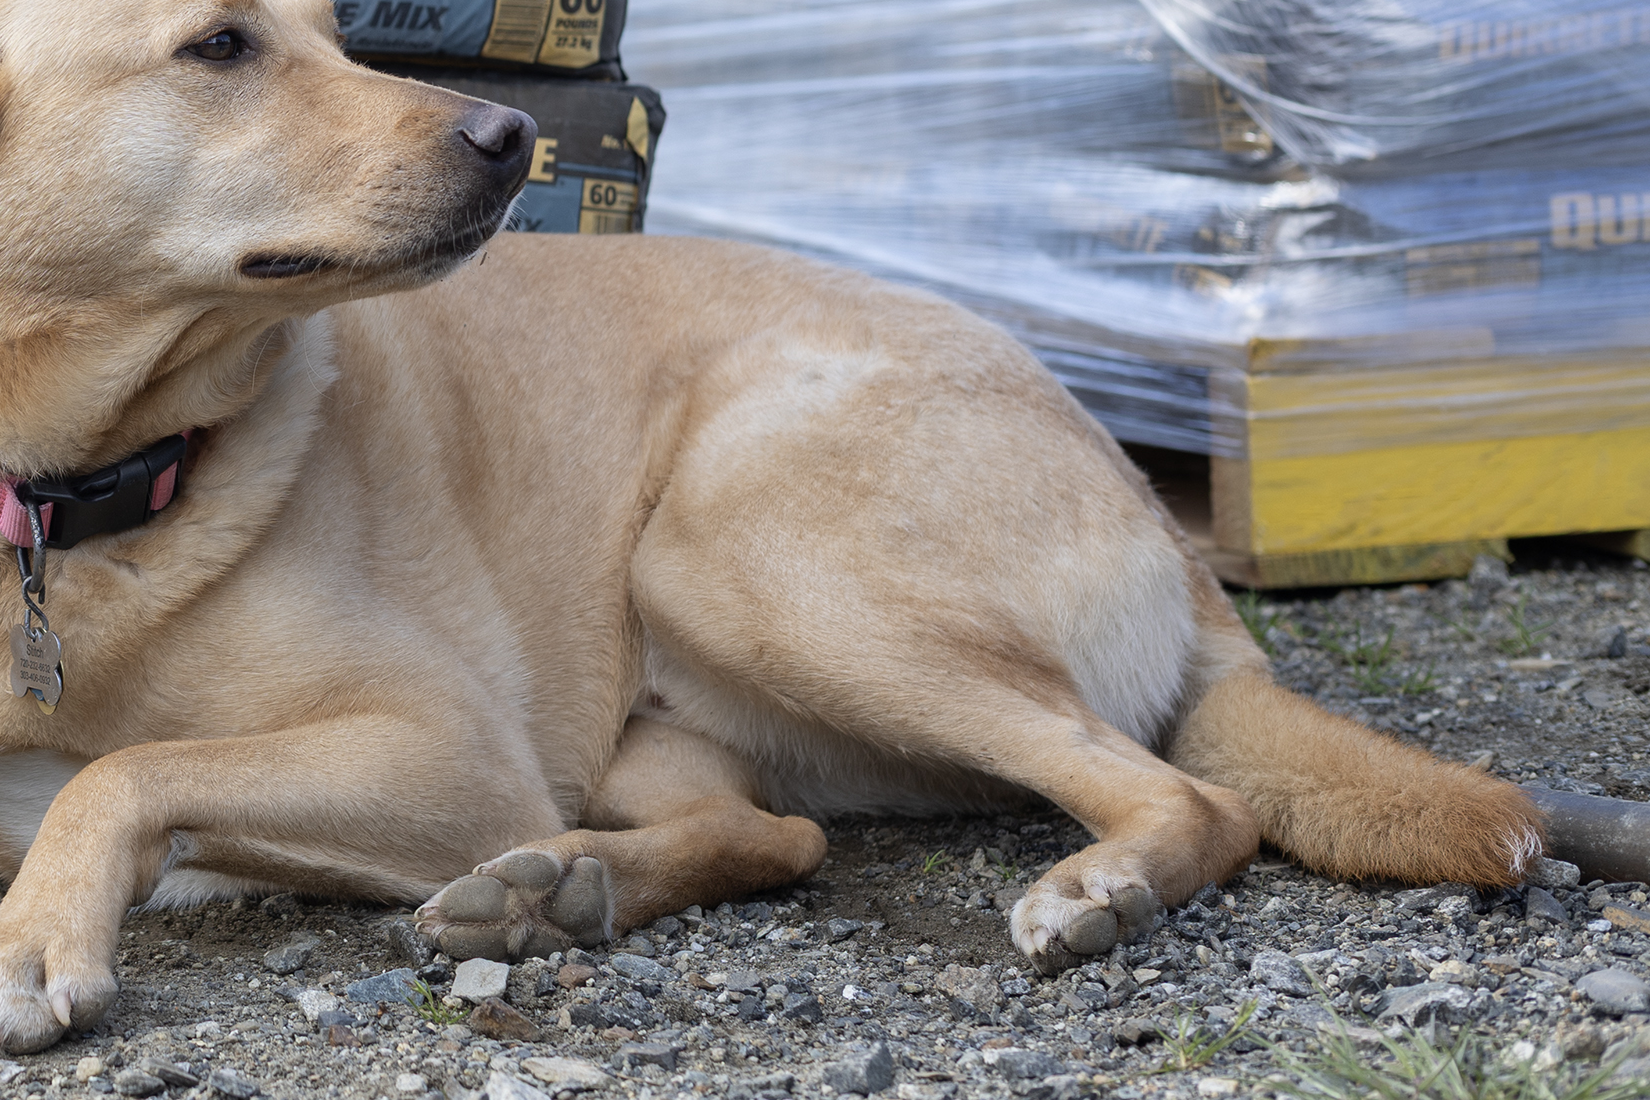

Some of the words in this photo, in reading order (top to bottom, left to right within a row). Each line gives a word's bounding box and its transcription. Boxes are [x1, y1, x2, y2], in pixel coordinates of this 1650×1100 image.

[369, 1, 449, 32] MIX
[555, 18, 598, 30] POUNDS
[590, 184, 617, 206] 60
[26, 644, 44, 658] Stitch
